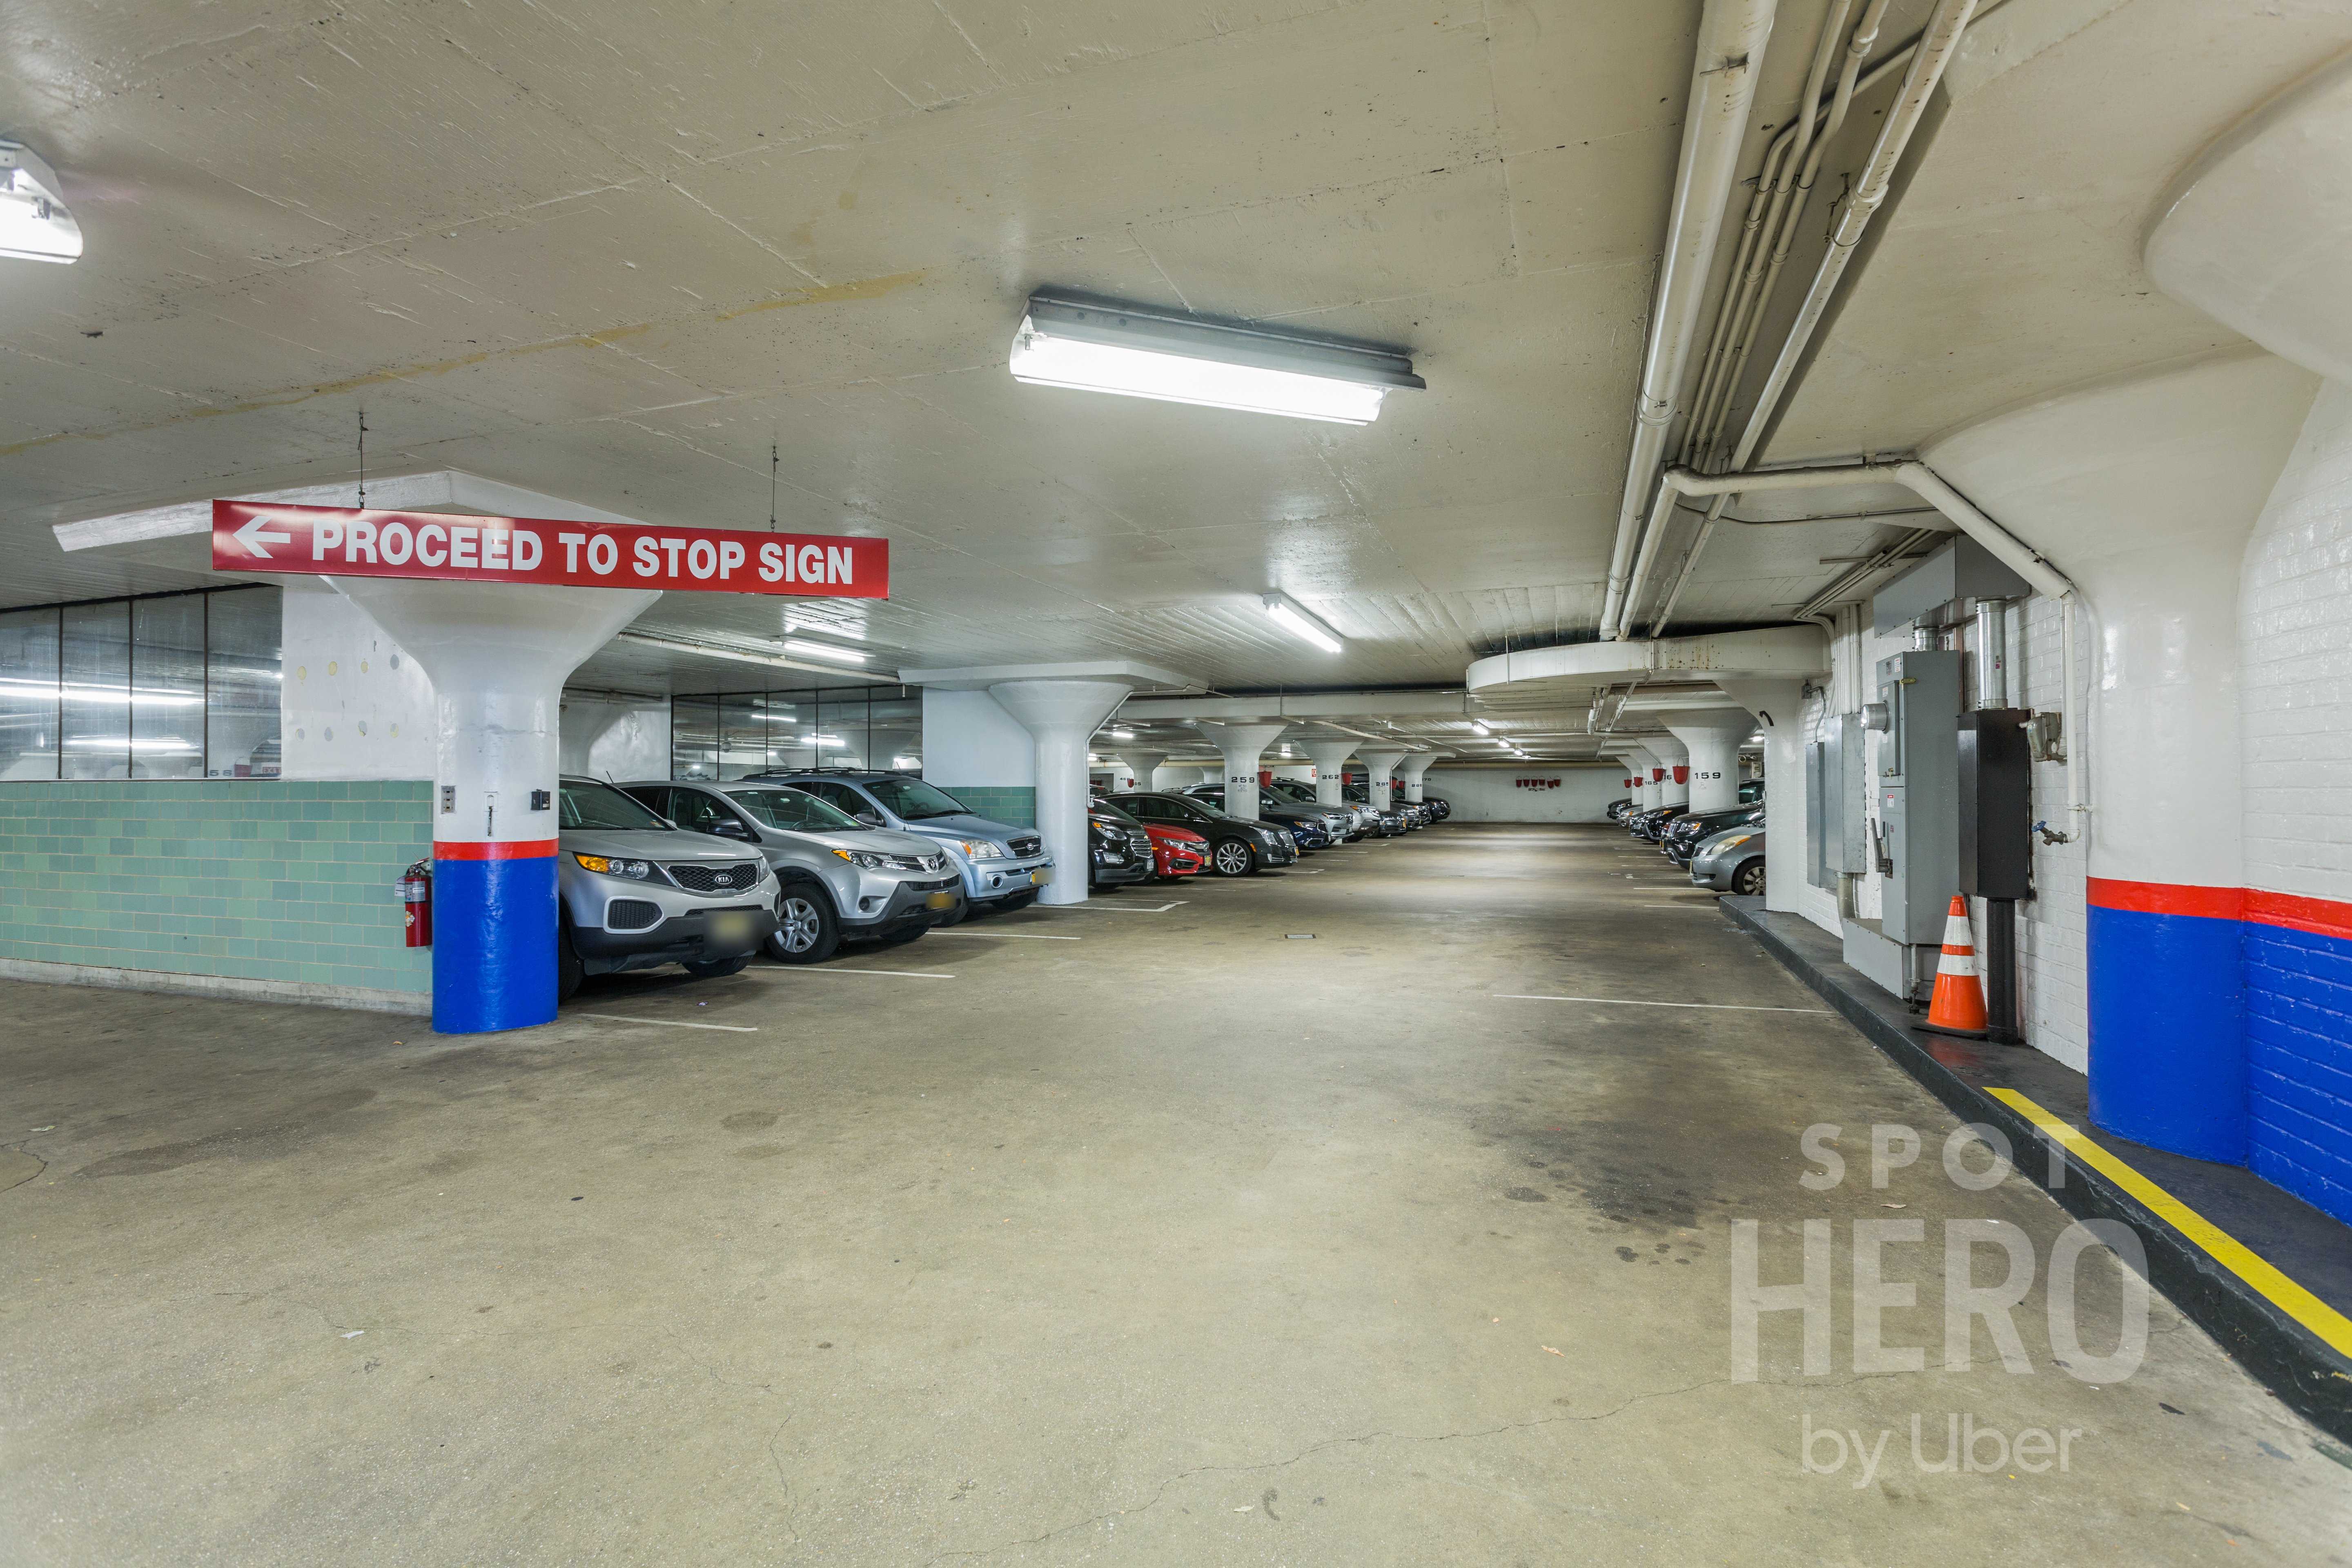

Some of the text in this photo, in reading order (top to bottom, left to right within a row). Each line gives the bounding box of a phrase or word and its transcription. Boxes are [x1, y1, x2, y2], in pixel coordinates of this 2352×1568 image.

[313, 517, 853, 585] PROCEED TO STOP SIGN
